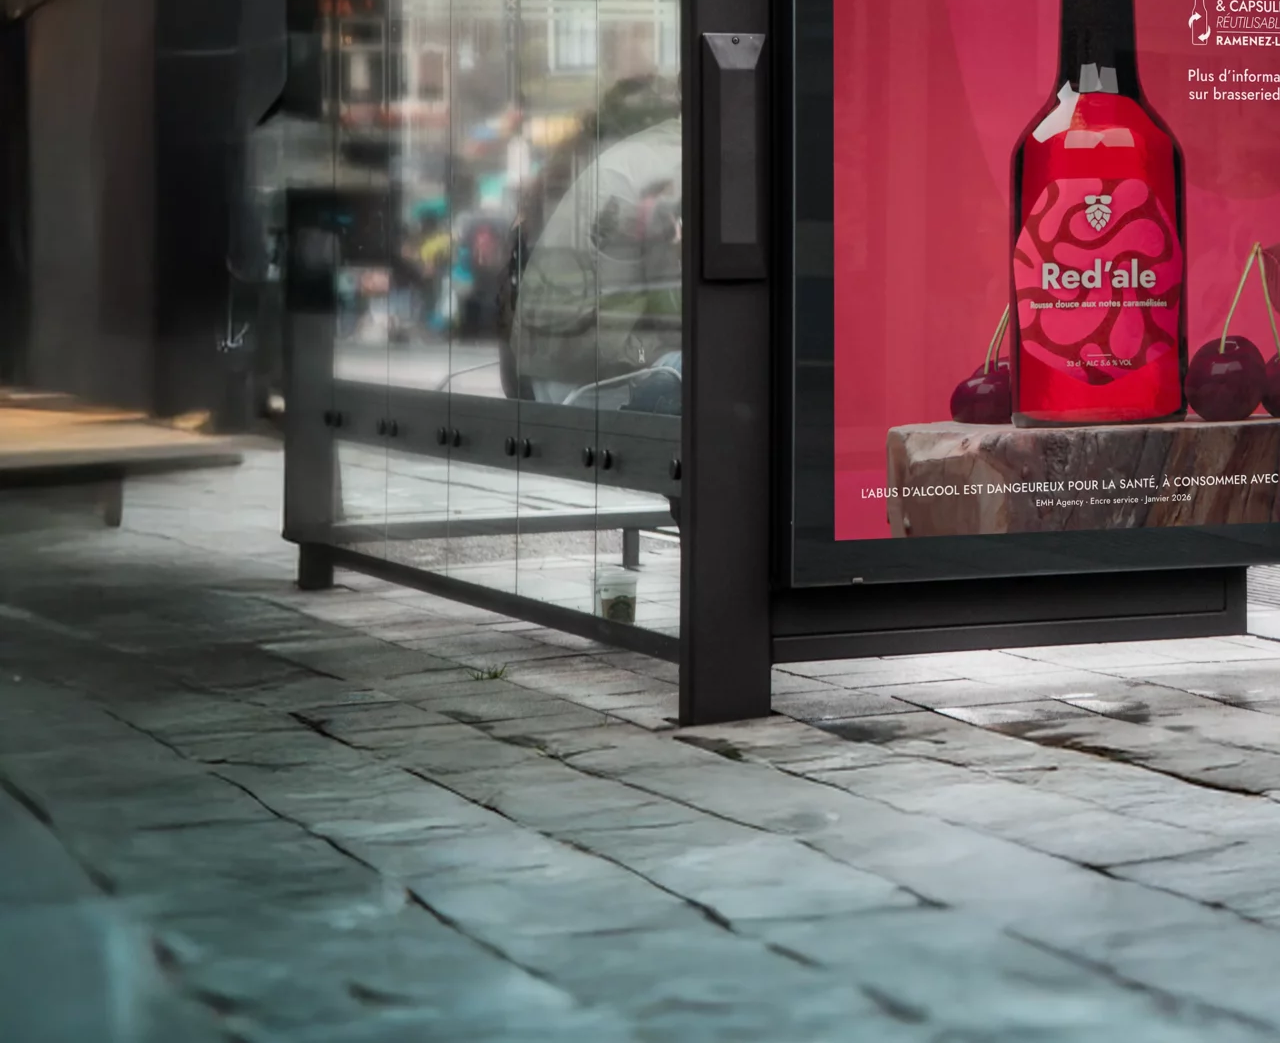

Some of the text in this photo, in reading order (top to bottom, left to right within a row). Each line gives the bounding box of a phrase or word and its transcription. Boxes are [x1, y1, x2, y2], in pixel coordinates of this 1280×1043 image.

[1215, 0, 1226, 12] &
[1188, 68, 1215, 82] Plus
[1188, 90, 1209, 100] sur
[1041, 258, 1157, 290] Red'ale
[1030, 301, 1053, 309] Rousse
[1055, 299, 1079, 308] douce
[1099, 299, 1121, 308] notes
[1122, 298, 1168, 307] caramélisées
[1100, 359, 1111, 367] 5.6
[861, 487, 899, 499] L'ABUS
[902, 485, 960, 497] D'ALCOOL
[963, 484, 984, 495] EST
[987, 481, 1065, 494] DANGEUREUX
[1068, 480, 1100, 491] POUR
[1102, 479, 1116, 490] LA
[1119, 475, 1159, 490] SANTÉ,
[1162, 474, 1171, 487] À
[1173, 474, 1248, 488] CONSOMMER
[1250, 473, 1279, 484] AVEC
[1036, 499, 1054, 507] EMH
[1056, 499, 1084, 508] Agency
[1090, 497, 1111, 505] Encre
[1113, 496, 1139, 504] service
[1144, 495, 1170, 505] Janvier
[1171, 493, 1192, 502] 2026
